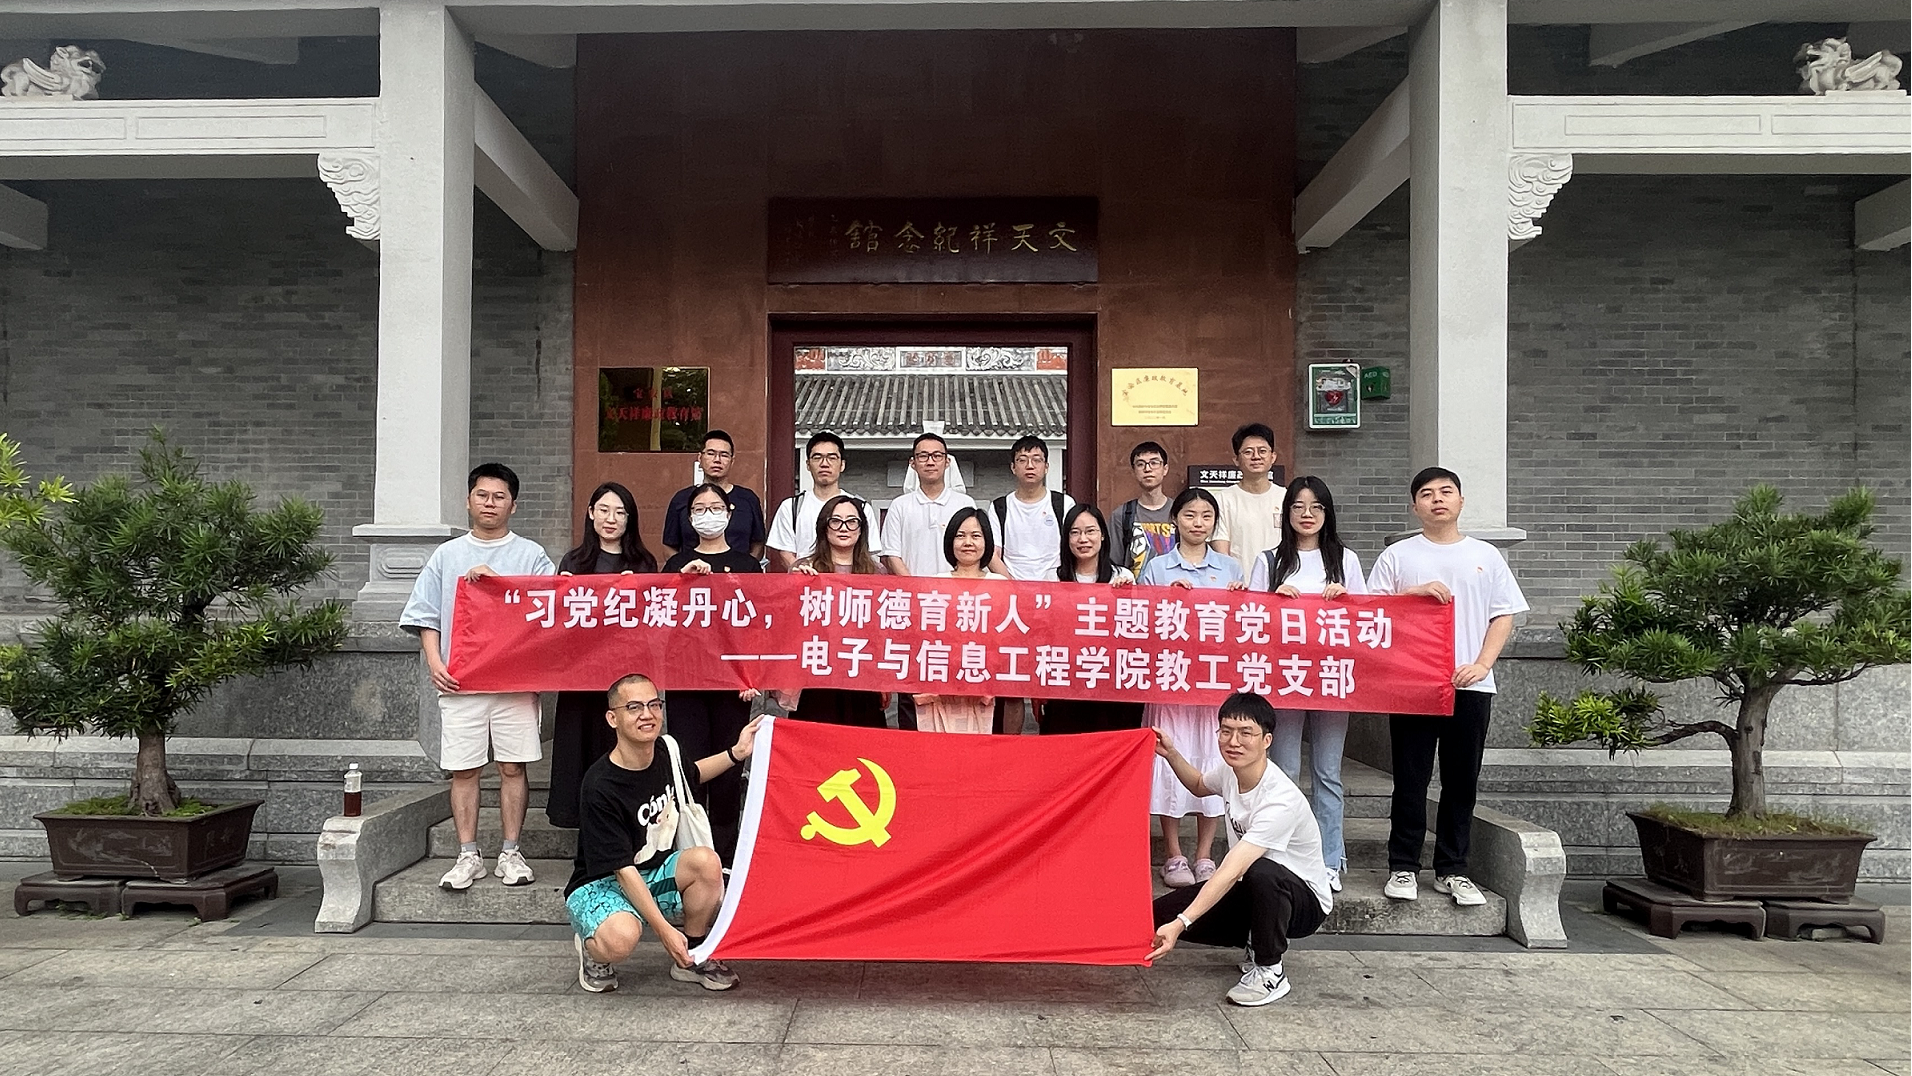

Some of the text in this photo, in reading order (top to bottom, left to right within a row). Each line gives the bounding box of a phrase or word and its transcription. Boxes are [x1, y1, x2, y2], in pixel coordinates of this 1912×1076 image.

[843, 221, 1078, 255] 文天祥紀念館
